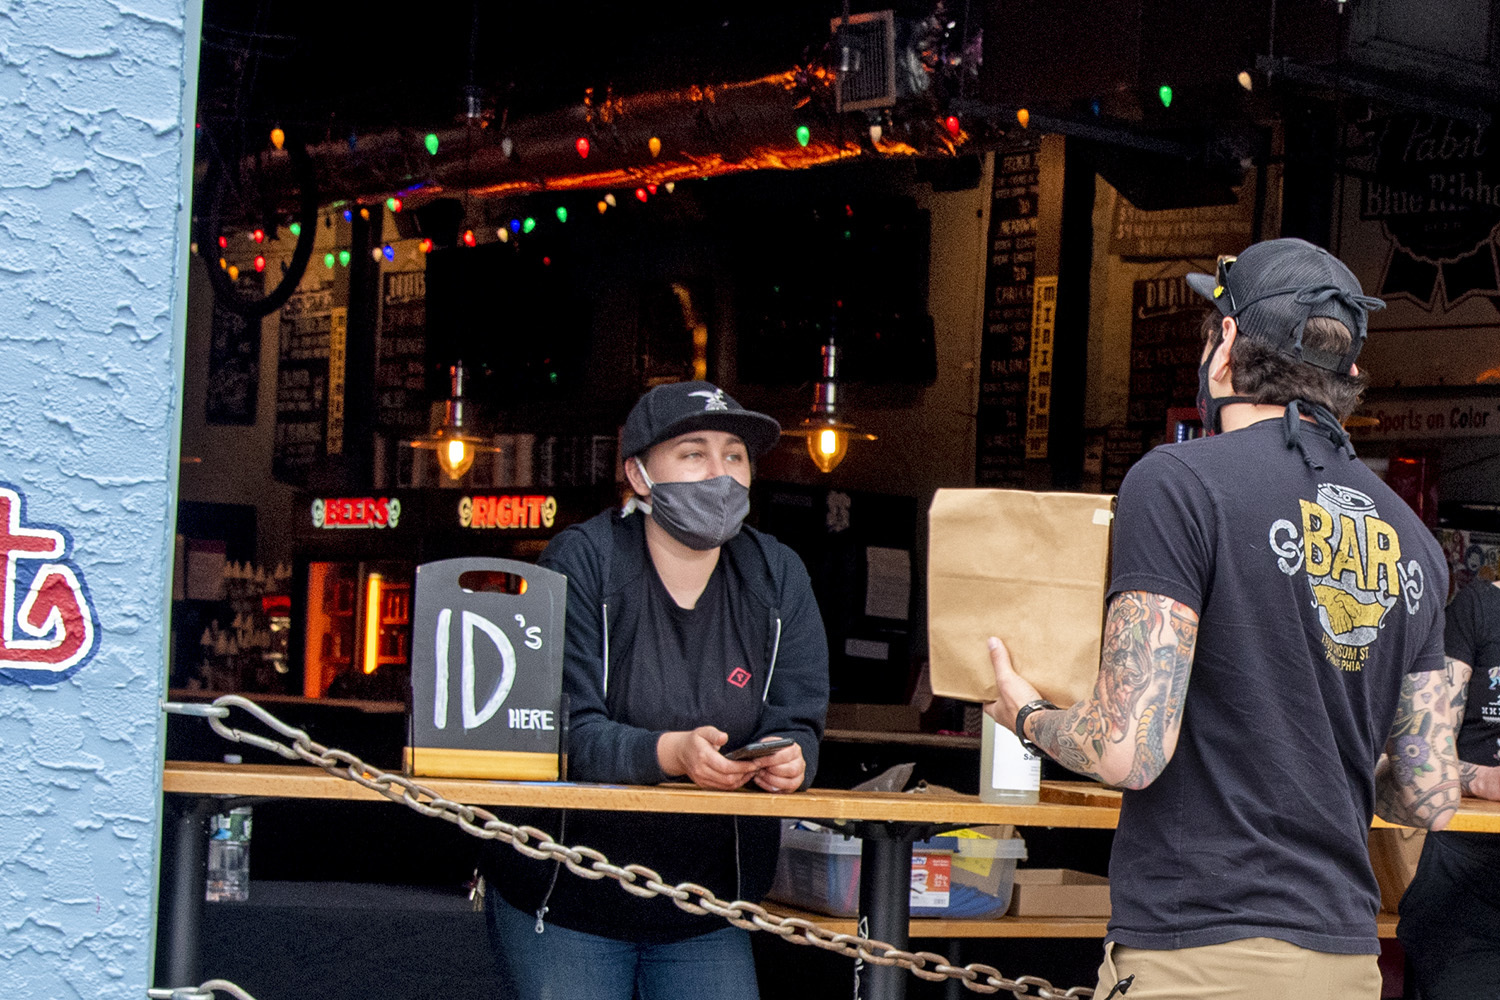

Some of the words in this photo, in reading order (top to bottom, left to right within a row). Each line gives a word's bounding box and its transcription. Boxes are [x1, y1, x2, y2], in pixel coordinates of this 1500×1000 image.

[1378, 406, 1422, 434] Sports
[1426, 413, 1445, 430] on
[1450, 406, 1490, 430] Color
[471, 495, 547, 529] RIGHT
[1299, 498, 1402, 597] BAR
[508, 708, 555, 731] HERE
